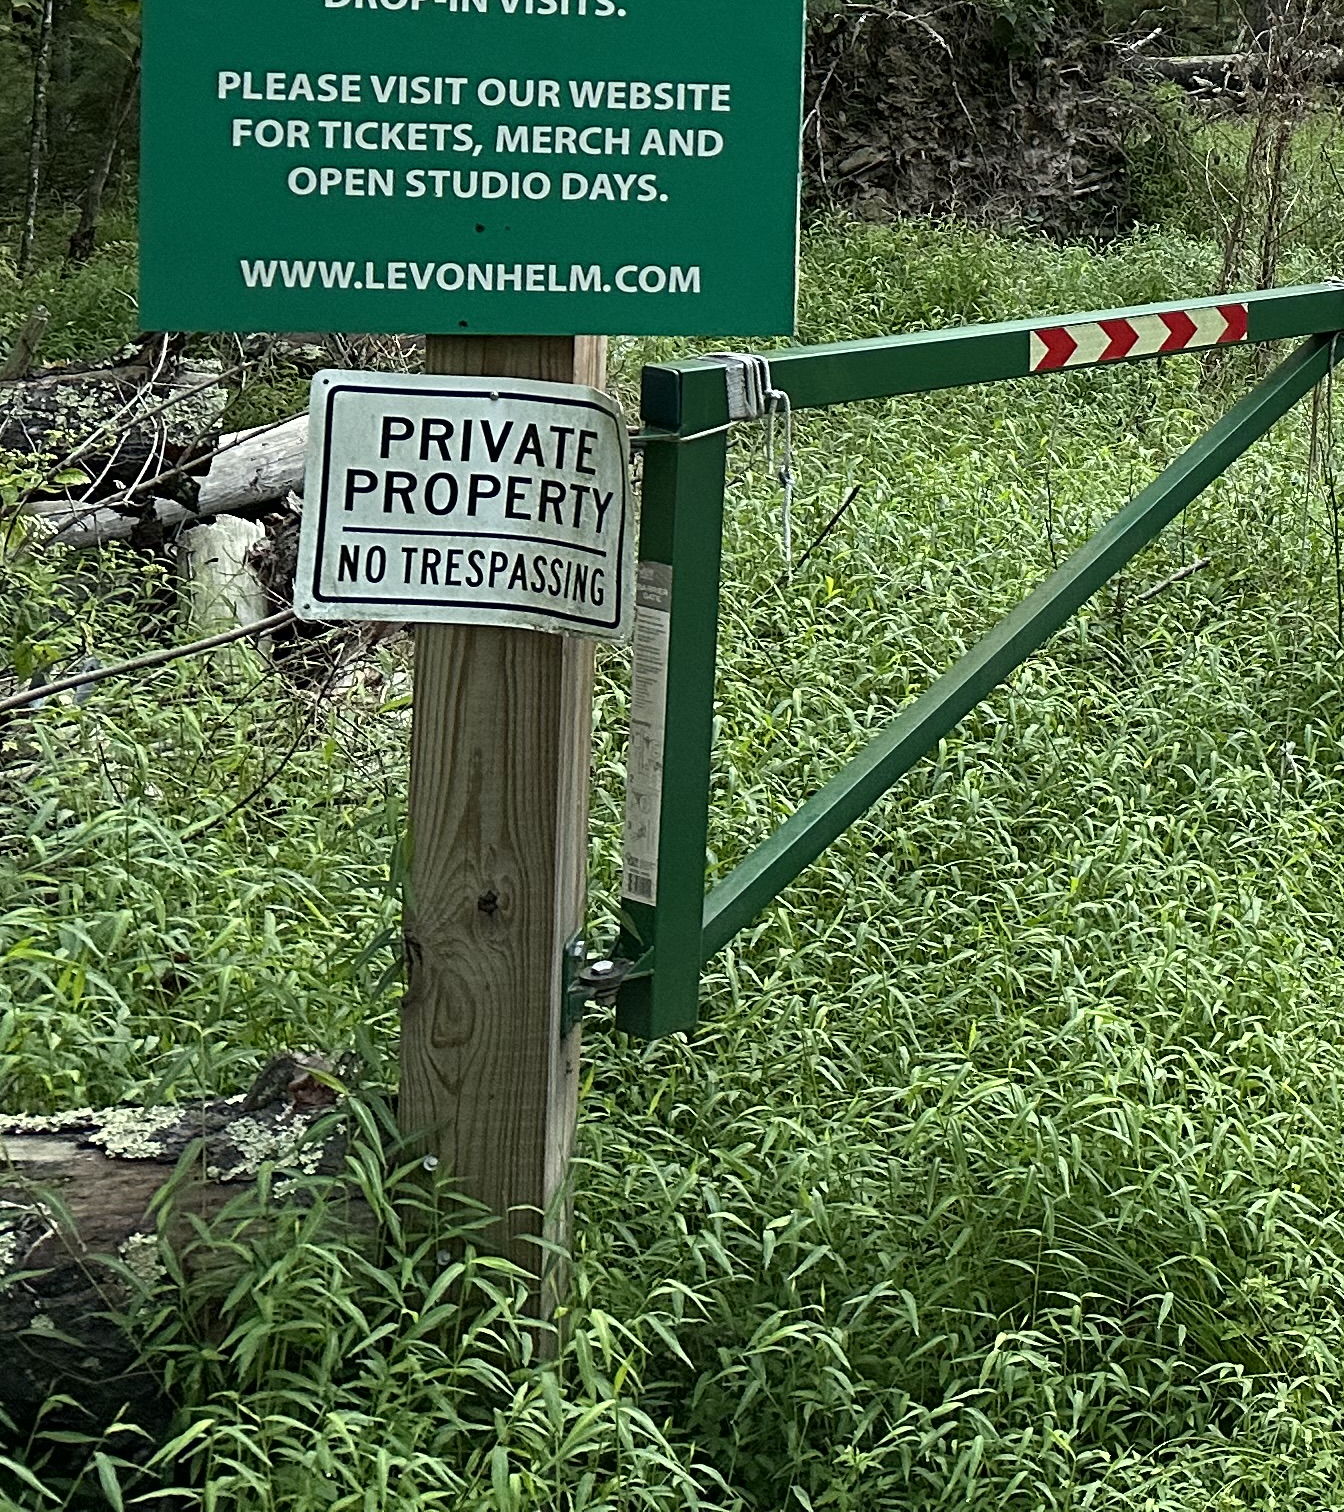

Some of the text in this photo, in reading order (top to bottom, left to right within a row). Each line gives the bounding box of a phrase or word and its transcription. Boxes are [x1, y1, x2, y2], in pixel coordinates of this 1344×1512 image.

[218, 72, 731, 112] PLEASE VISIT OUR WEBSITE
[232, 119, 724, 157] FOR TICKETS, MERCH AND
[287, 167, 669, 203] OPEN STUDIO DAYS.
[240, 260, 701, 294] WWW.LEVONHELM.COM
[380, 416, 599, 476] PRIVATE
[344, 468, 614, 534] PROPERTY
[337, 544, 605, 607] NO TRESPASSING
